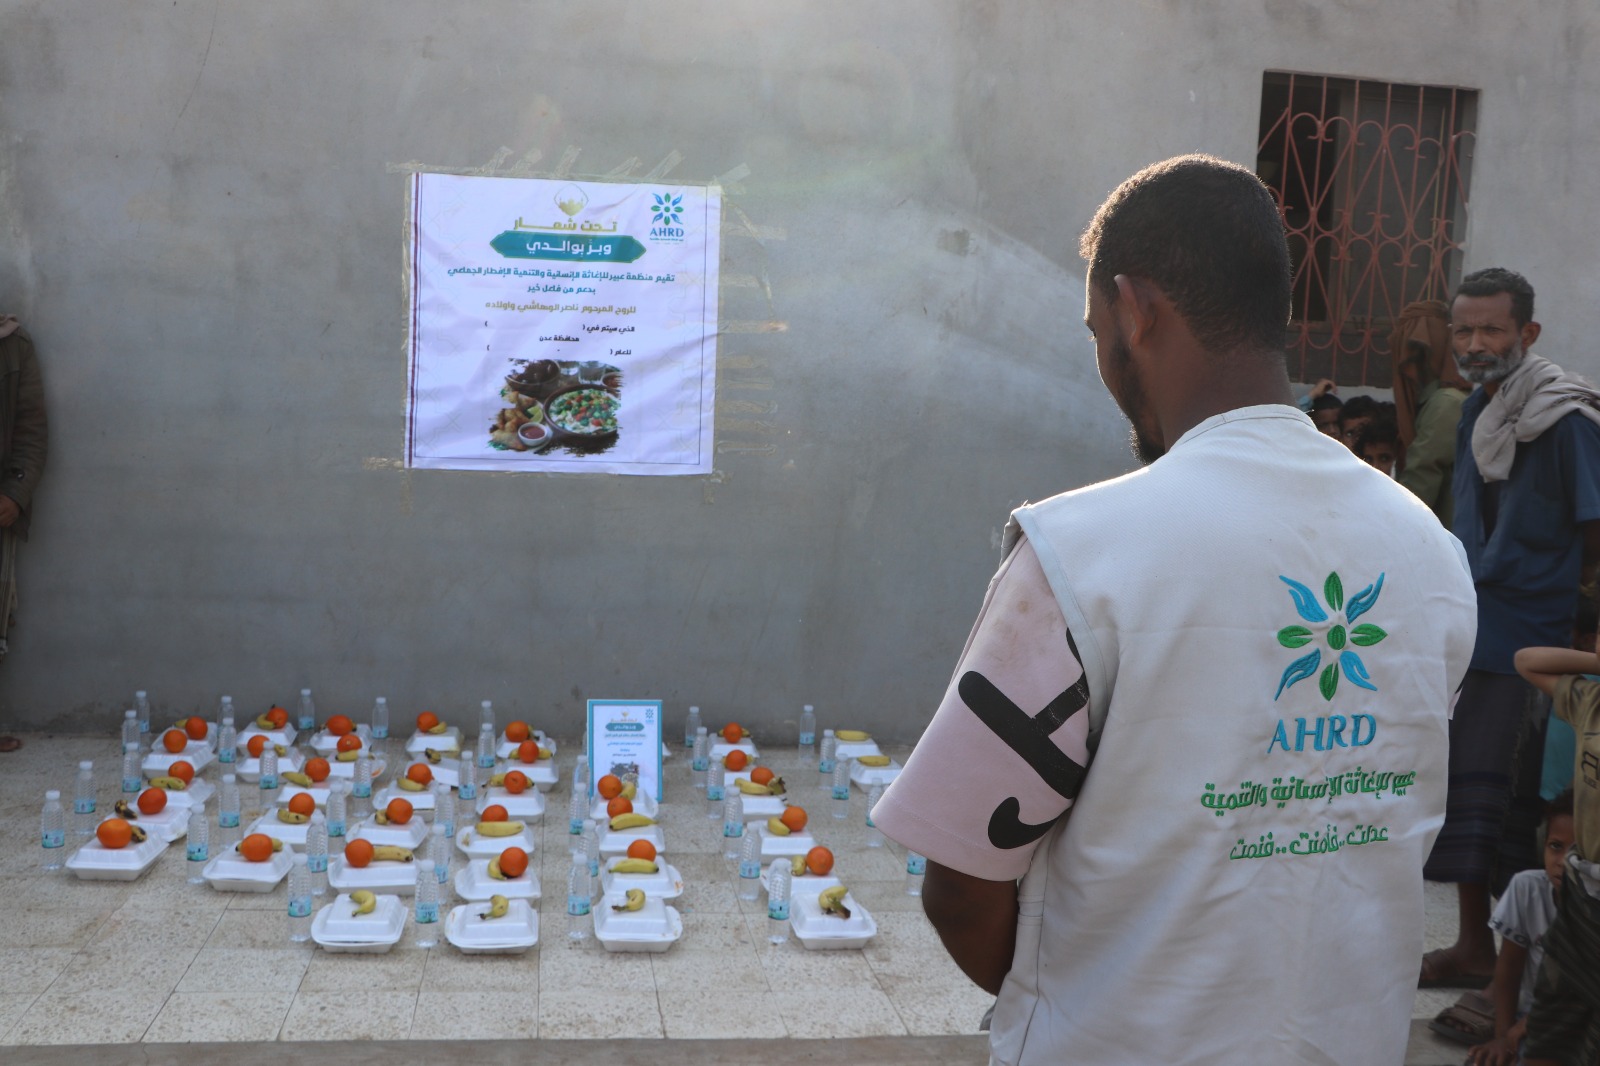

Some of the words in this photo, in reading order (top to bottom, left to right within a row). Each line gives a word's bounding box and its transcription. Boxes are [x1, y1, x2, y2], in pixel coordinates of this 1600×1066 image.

[514, 216, 577, 231] شعار
[581, 219, 617, 232] تحت
[650, 227, 685, 238] AHRD
[447, 266, 482, 276] الجماعي
[513, 267, 545, 278] والتنمية
[547, 269, 580, 281] الإنسانية
[581, 269, 609, 281] للإغاثة
[626, 271, 653, 281] منظمة
[609, 273, 625, 282] عبير
[655, 273, 675, 283] تقيم
[527, 283, 541, 293] خير
[542, 284, 561, 293] فاعل
[562, 286, 574, 294] من
[576, 286, 596, 295] بدعم
[560, 304, 579, 313] ناصر
[581, 304, 613, 314] المرحوم
[586, 324, 600, 333] في
[600, 325, 618, 333] سيتم
[618, 325, 636, 334] الذي
[1267, 714, 1377, 754] AHRD
[1344, 766, 1394, 799] للإغاثة
[1270, 774, 1344, 804] الإنسانية
[1201, 779, 1268, 816] والتنمية
